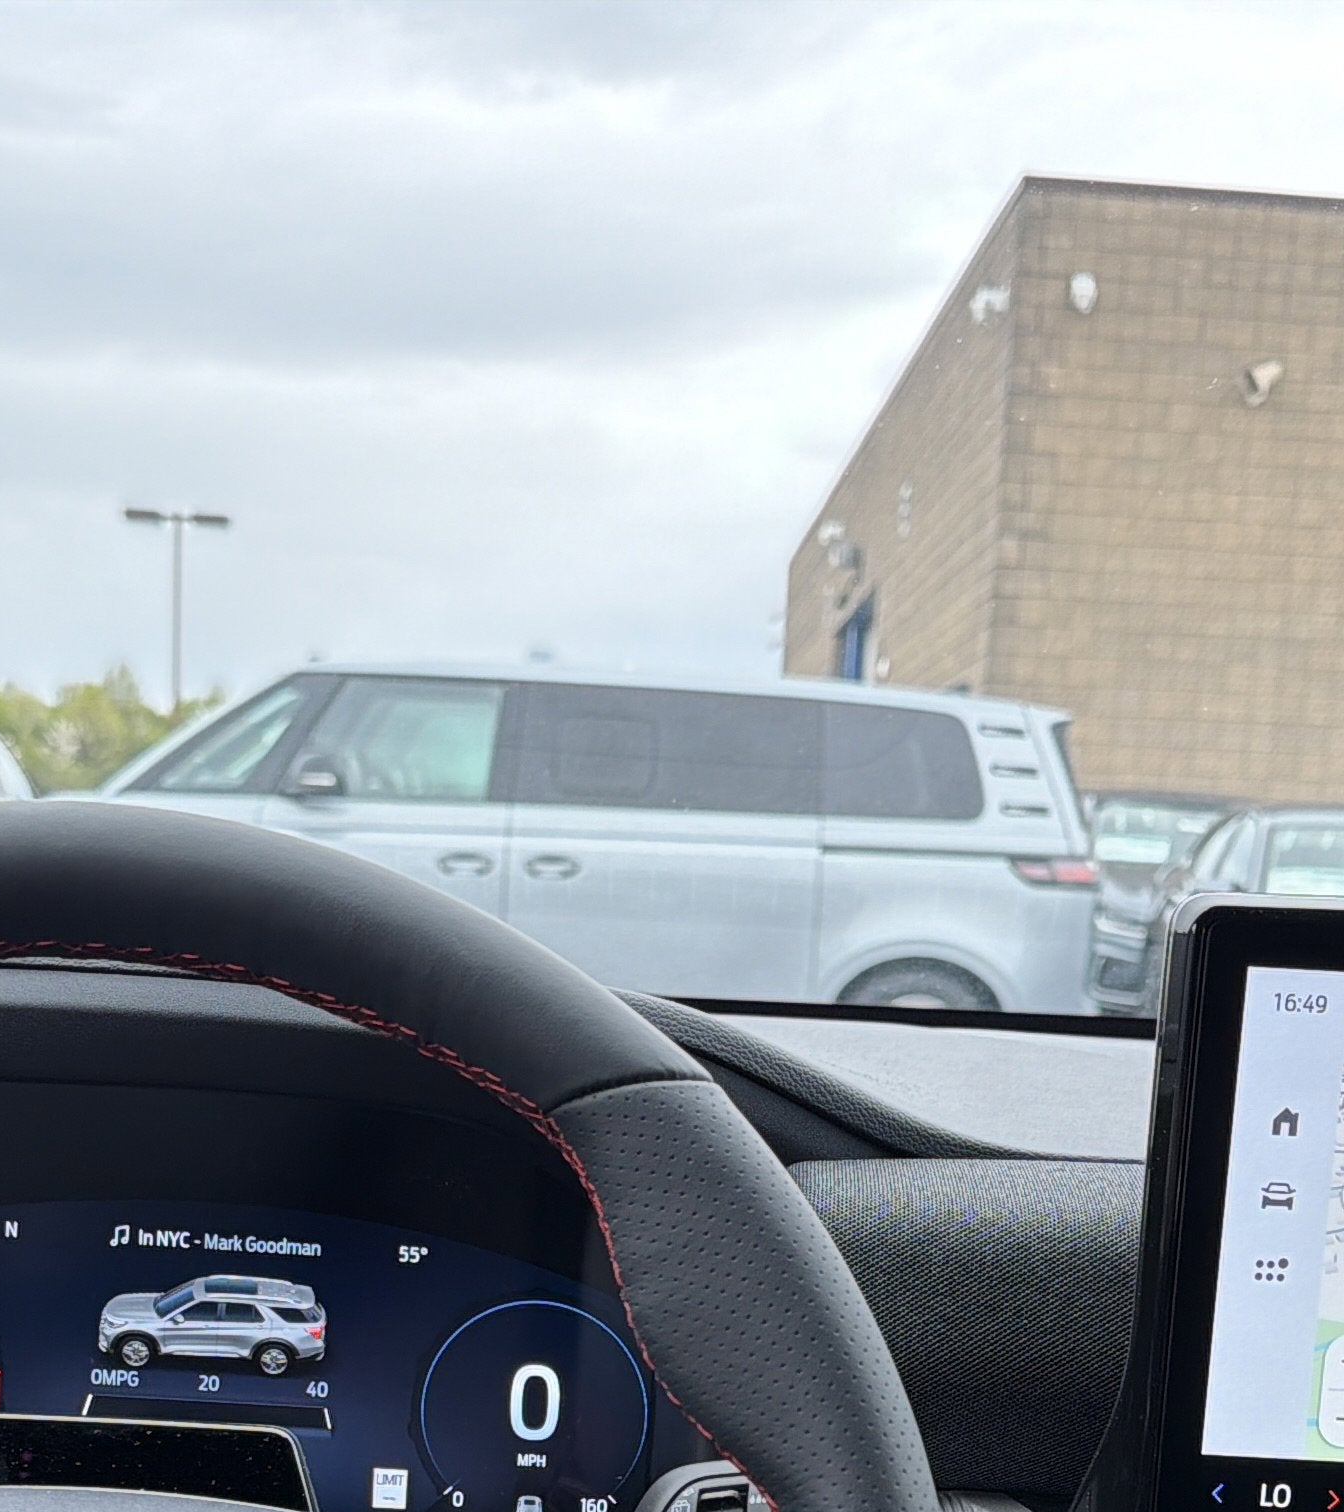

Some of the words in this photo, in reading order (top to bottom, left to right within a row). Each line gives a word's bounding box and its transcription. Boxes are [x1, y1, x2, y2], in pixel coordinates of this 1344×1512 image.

[1274, 992, 1329, 1014] 16:49
[5, 1220, 18, 1238] N
[138, 1228, 154, 1246] In
[157, 1229, 190, 1248] NYC
[204, 1233, 242, 1253] Mark
[245, 1235, 321, 1257] Goodman
[398, 1246, 428, 1264] 55°
[198, 1374, 220, 1391] 20
[305, 1380, 328, 1398] 40
[509, 1363, 560, 1441] 0
[516, 1453, 546, 1468] MPH
[376, 1473, 405, 1487] LIMIT
[452, 1491, 465, 1508] 0
[1259, 1483, 1292, 1508] LO
